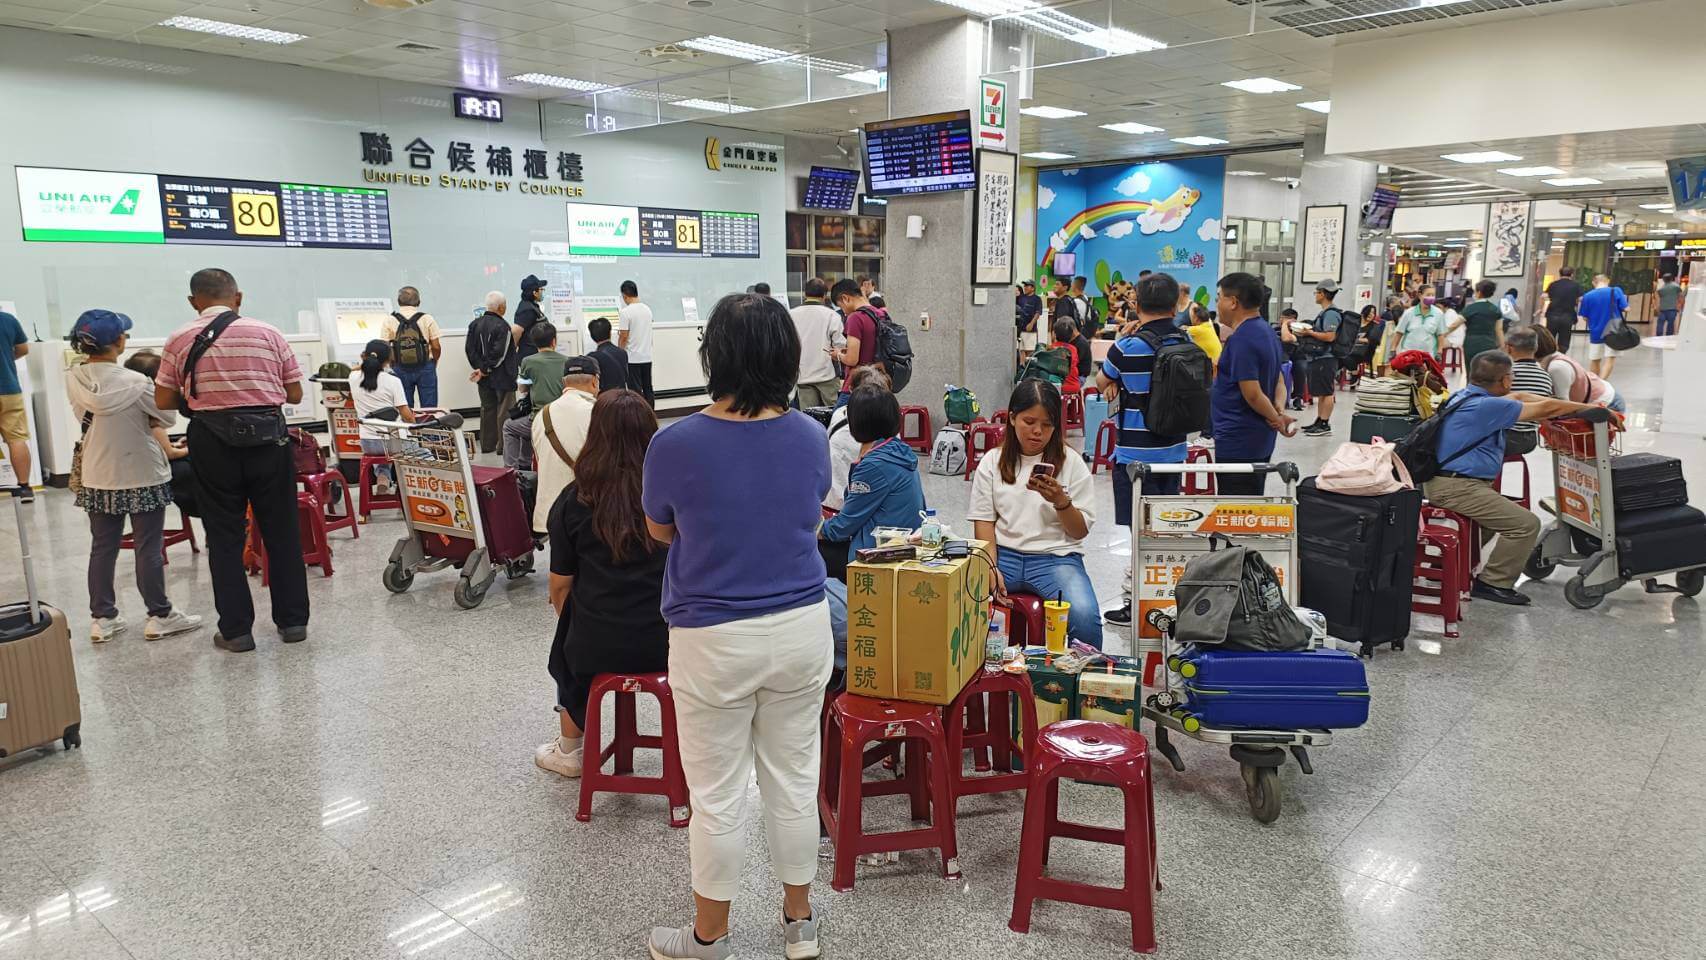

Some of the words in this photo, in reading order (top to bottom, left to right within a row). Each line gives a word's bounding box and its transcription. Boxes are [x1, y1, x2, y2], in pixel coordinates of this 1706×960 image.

[360, 131, 584, 182] 聯合候補櫃檯
[363, 168, 432, 186] UNIFIED
[519, 181, 584, 197] COUNTER
[38, 191, 75, 202] UNI
[79, 193, 112, 204] AIR
[238, 201, 275, 227] 80
[678, 224, 698, 244] 81
[1160, 511, 1194, 519] CST
[853, 572, 878, 690] 陳金福號
